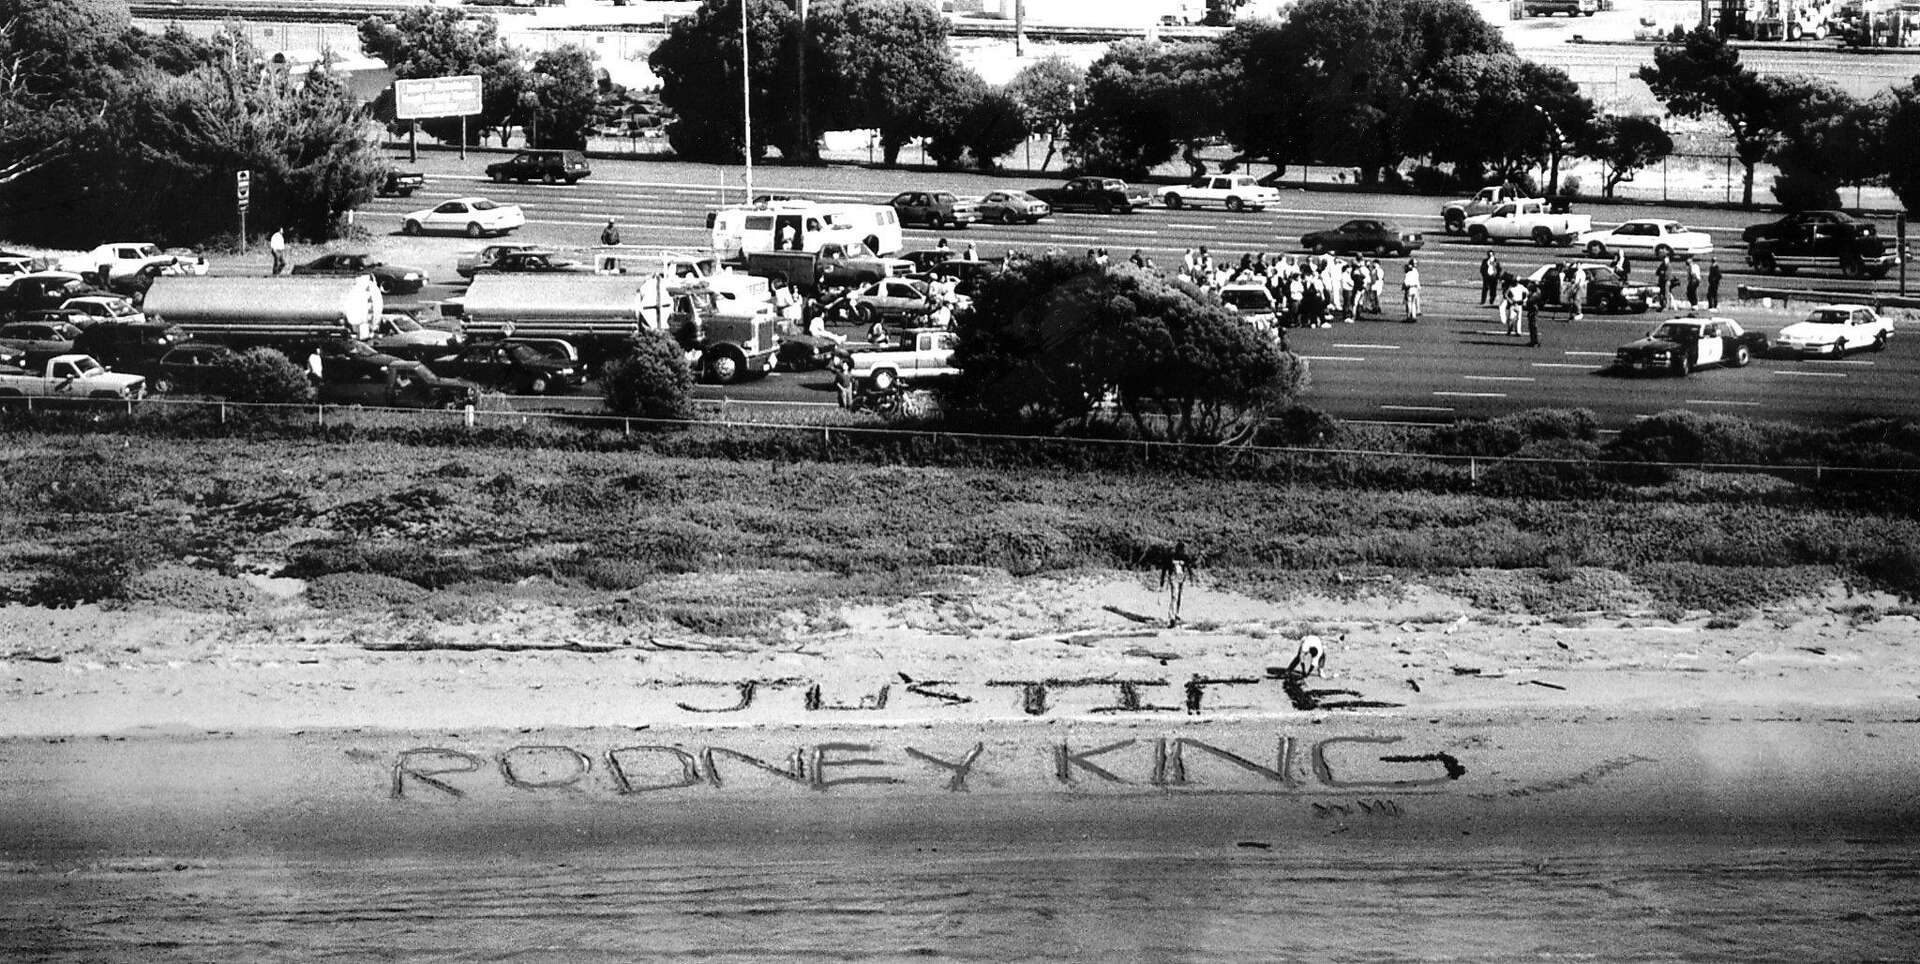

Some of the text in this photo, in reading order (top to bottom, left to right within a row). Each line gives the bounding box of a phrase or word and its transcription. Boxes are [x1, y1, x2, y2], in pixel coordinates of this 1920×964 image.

[676, 671, 1402, 714] JUSTICE
[391, 735, 1466, 799] RODNEY KING
